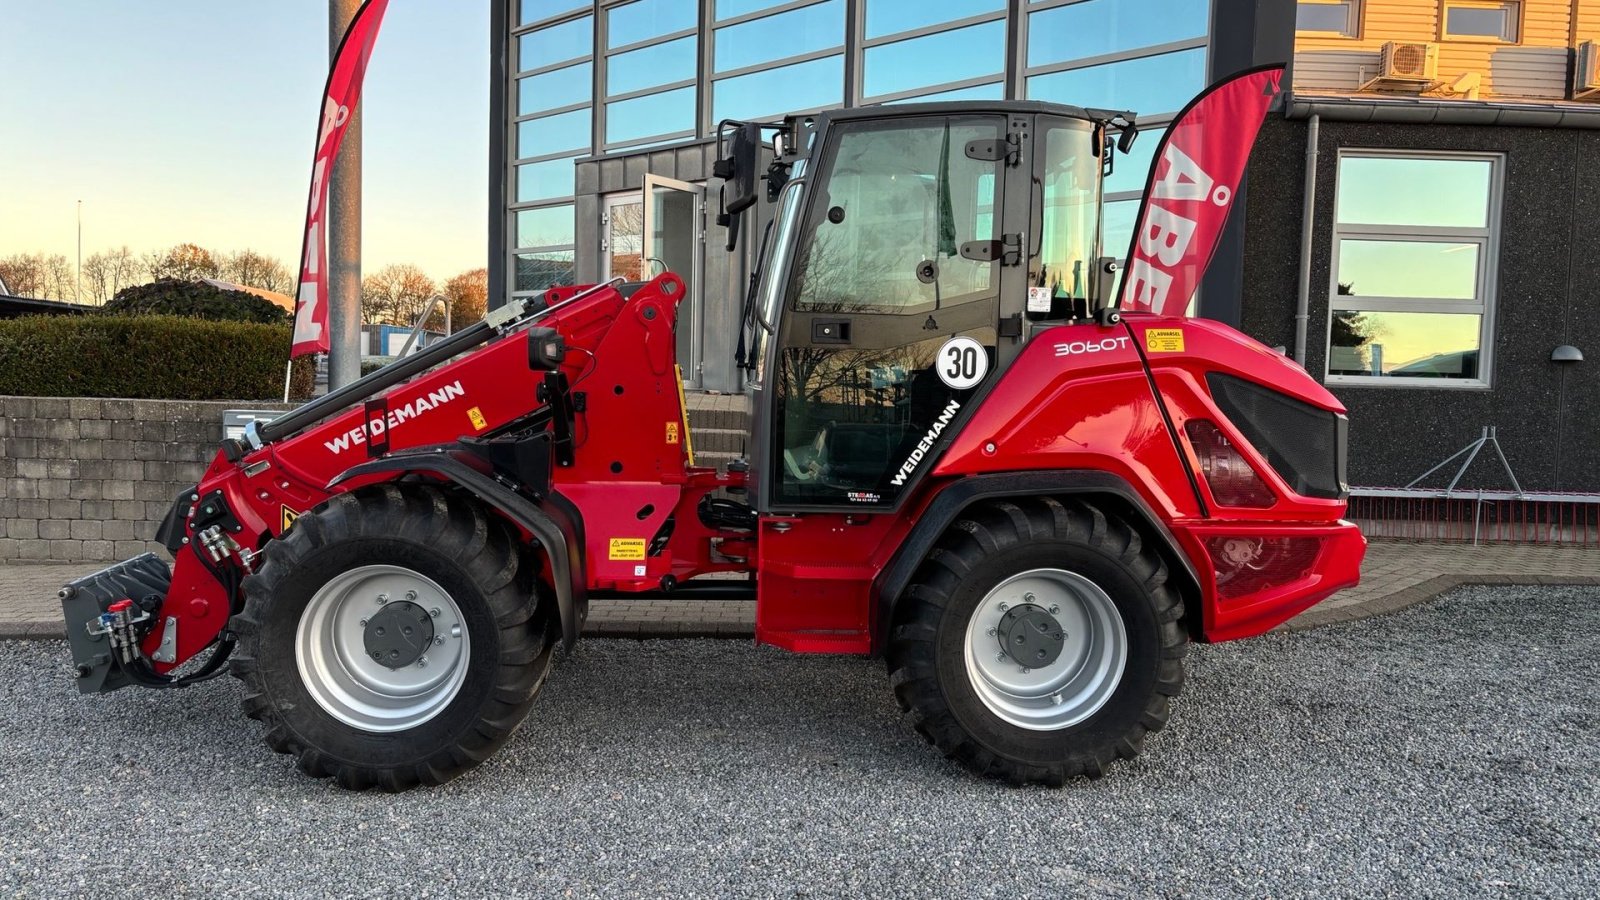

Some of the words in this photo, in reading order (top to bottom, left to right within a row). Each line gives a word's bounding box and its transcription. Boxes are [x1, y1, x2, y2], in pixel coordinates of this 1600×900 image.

[1121, 141, 1231, 315] ÅBE
[946, 346, 977, 380] 30
[1053, 336, 1129, 357] 3060T
[890, 399, 961, 486] WEIDEMANN
